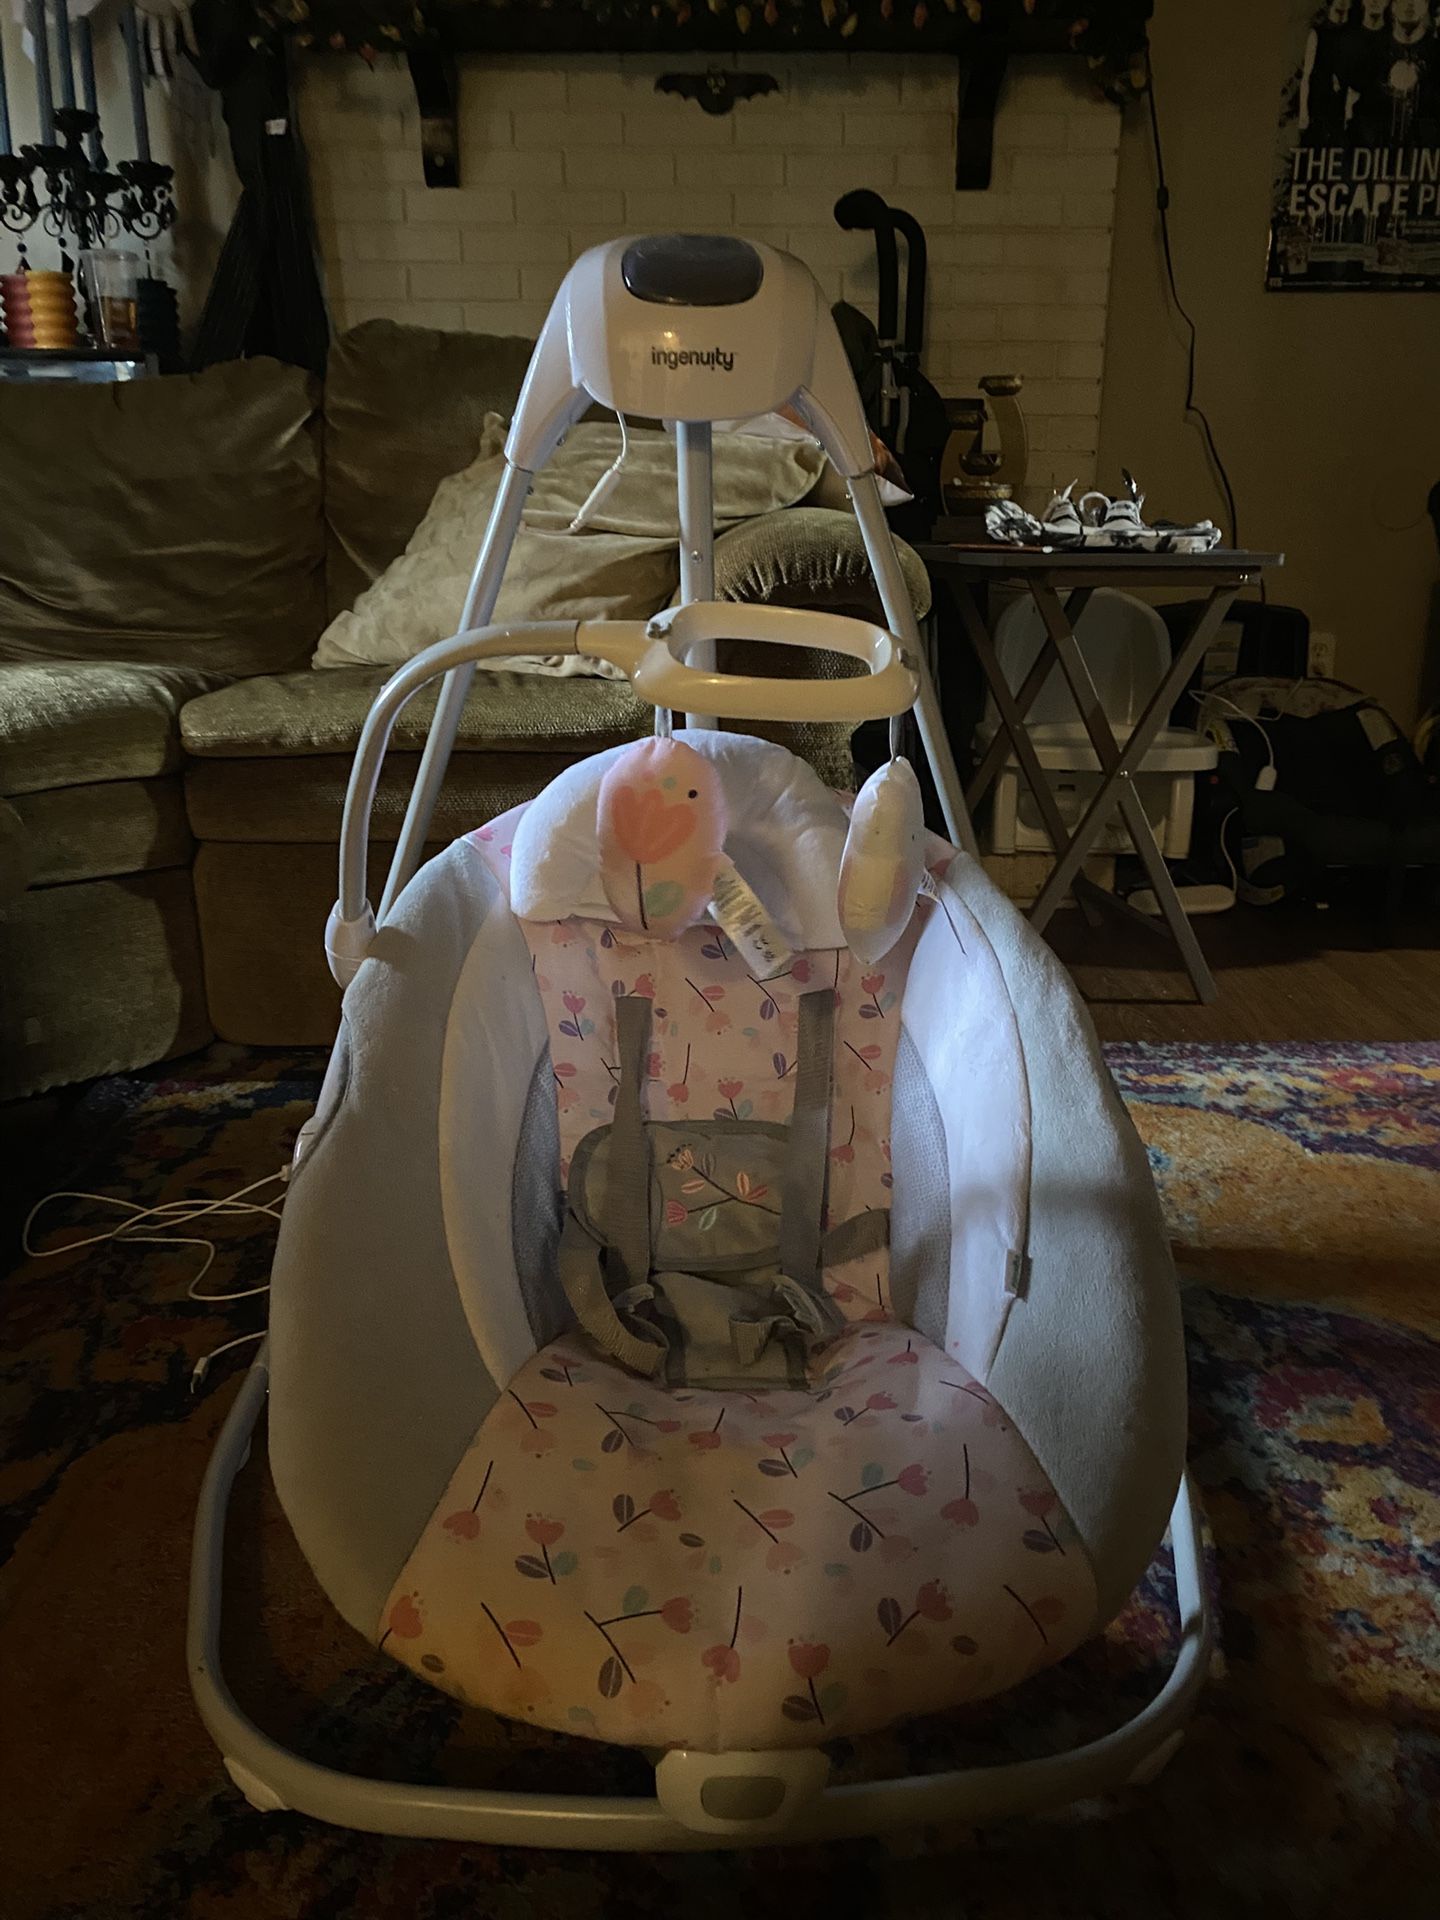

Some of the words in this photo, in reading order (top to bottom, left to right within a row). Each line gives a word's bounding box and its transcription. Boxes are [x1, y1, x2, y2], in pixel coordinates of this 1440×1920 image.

[1291, 148, 1344, 181] THE
[1289, 184, 1409, 217] ESCAPE
[651, 347, 735, 371] ingenuity
